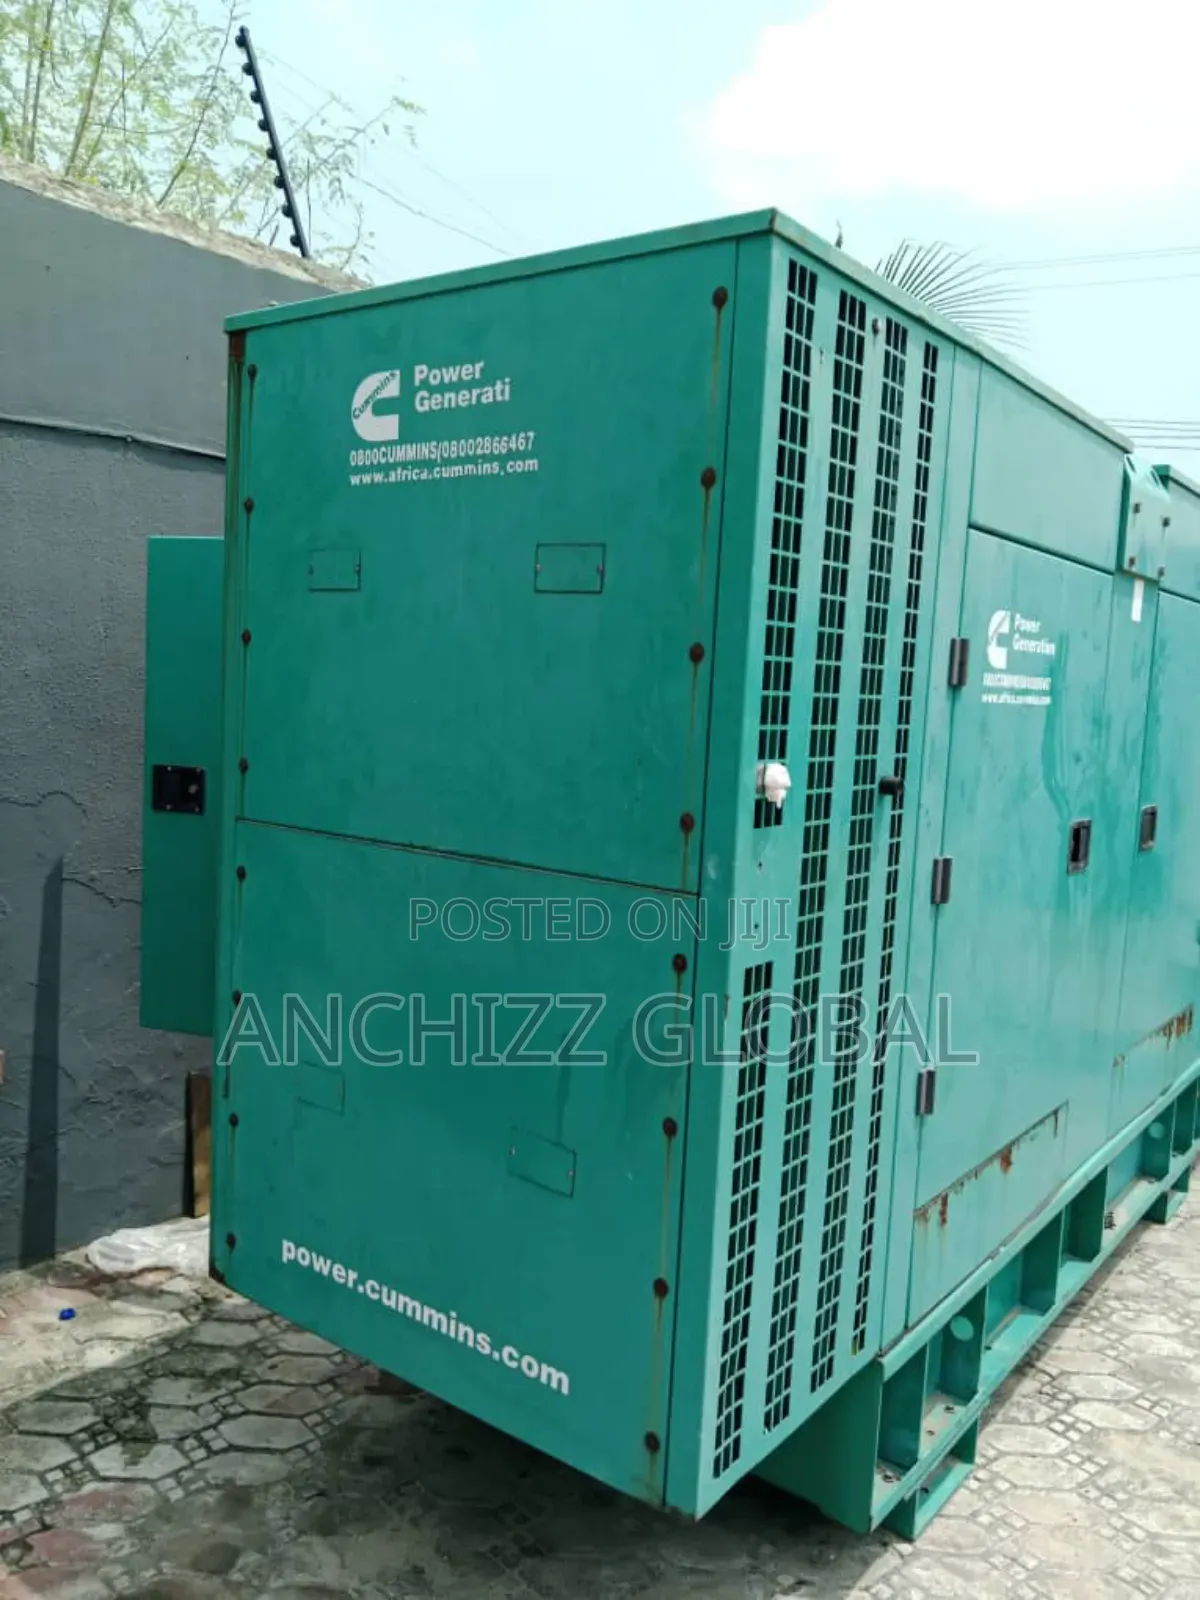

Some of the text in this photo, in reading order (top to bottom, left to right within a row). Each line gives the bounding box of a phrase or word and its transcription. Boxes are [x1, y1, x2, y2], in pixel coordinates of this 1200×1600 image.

[351, 370, 398, 420] Cummins
[413, 360, 485, 387] Power
[414, 377, 511, 413] Generati
[281, 1238, 570, 1396] power.cummins.com
